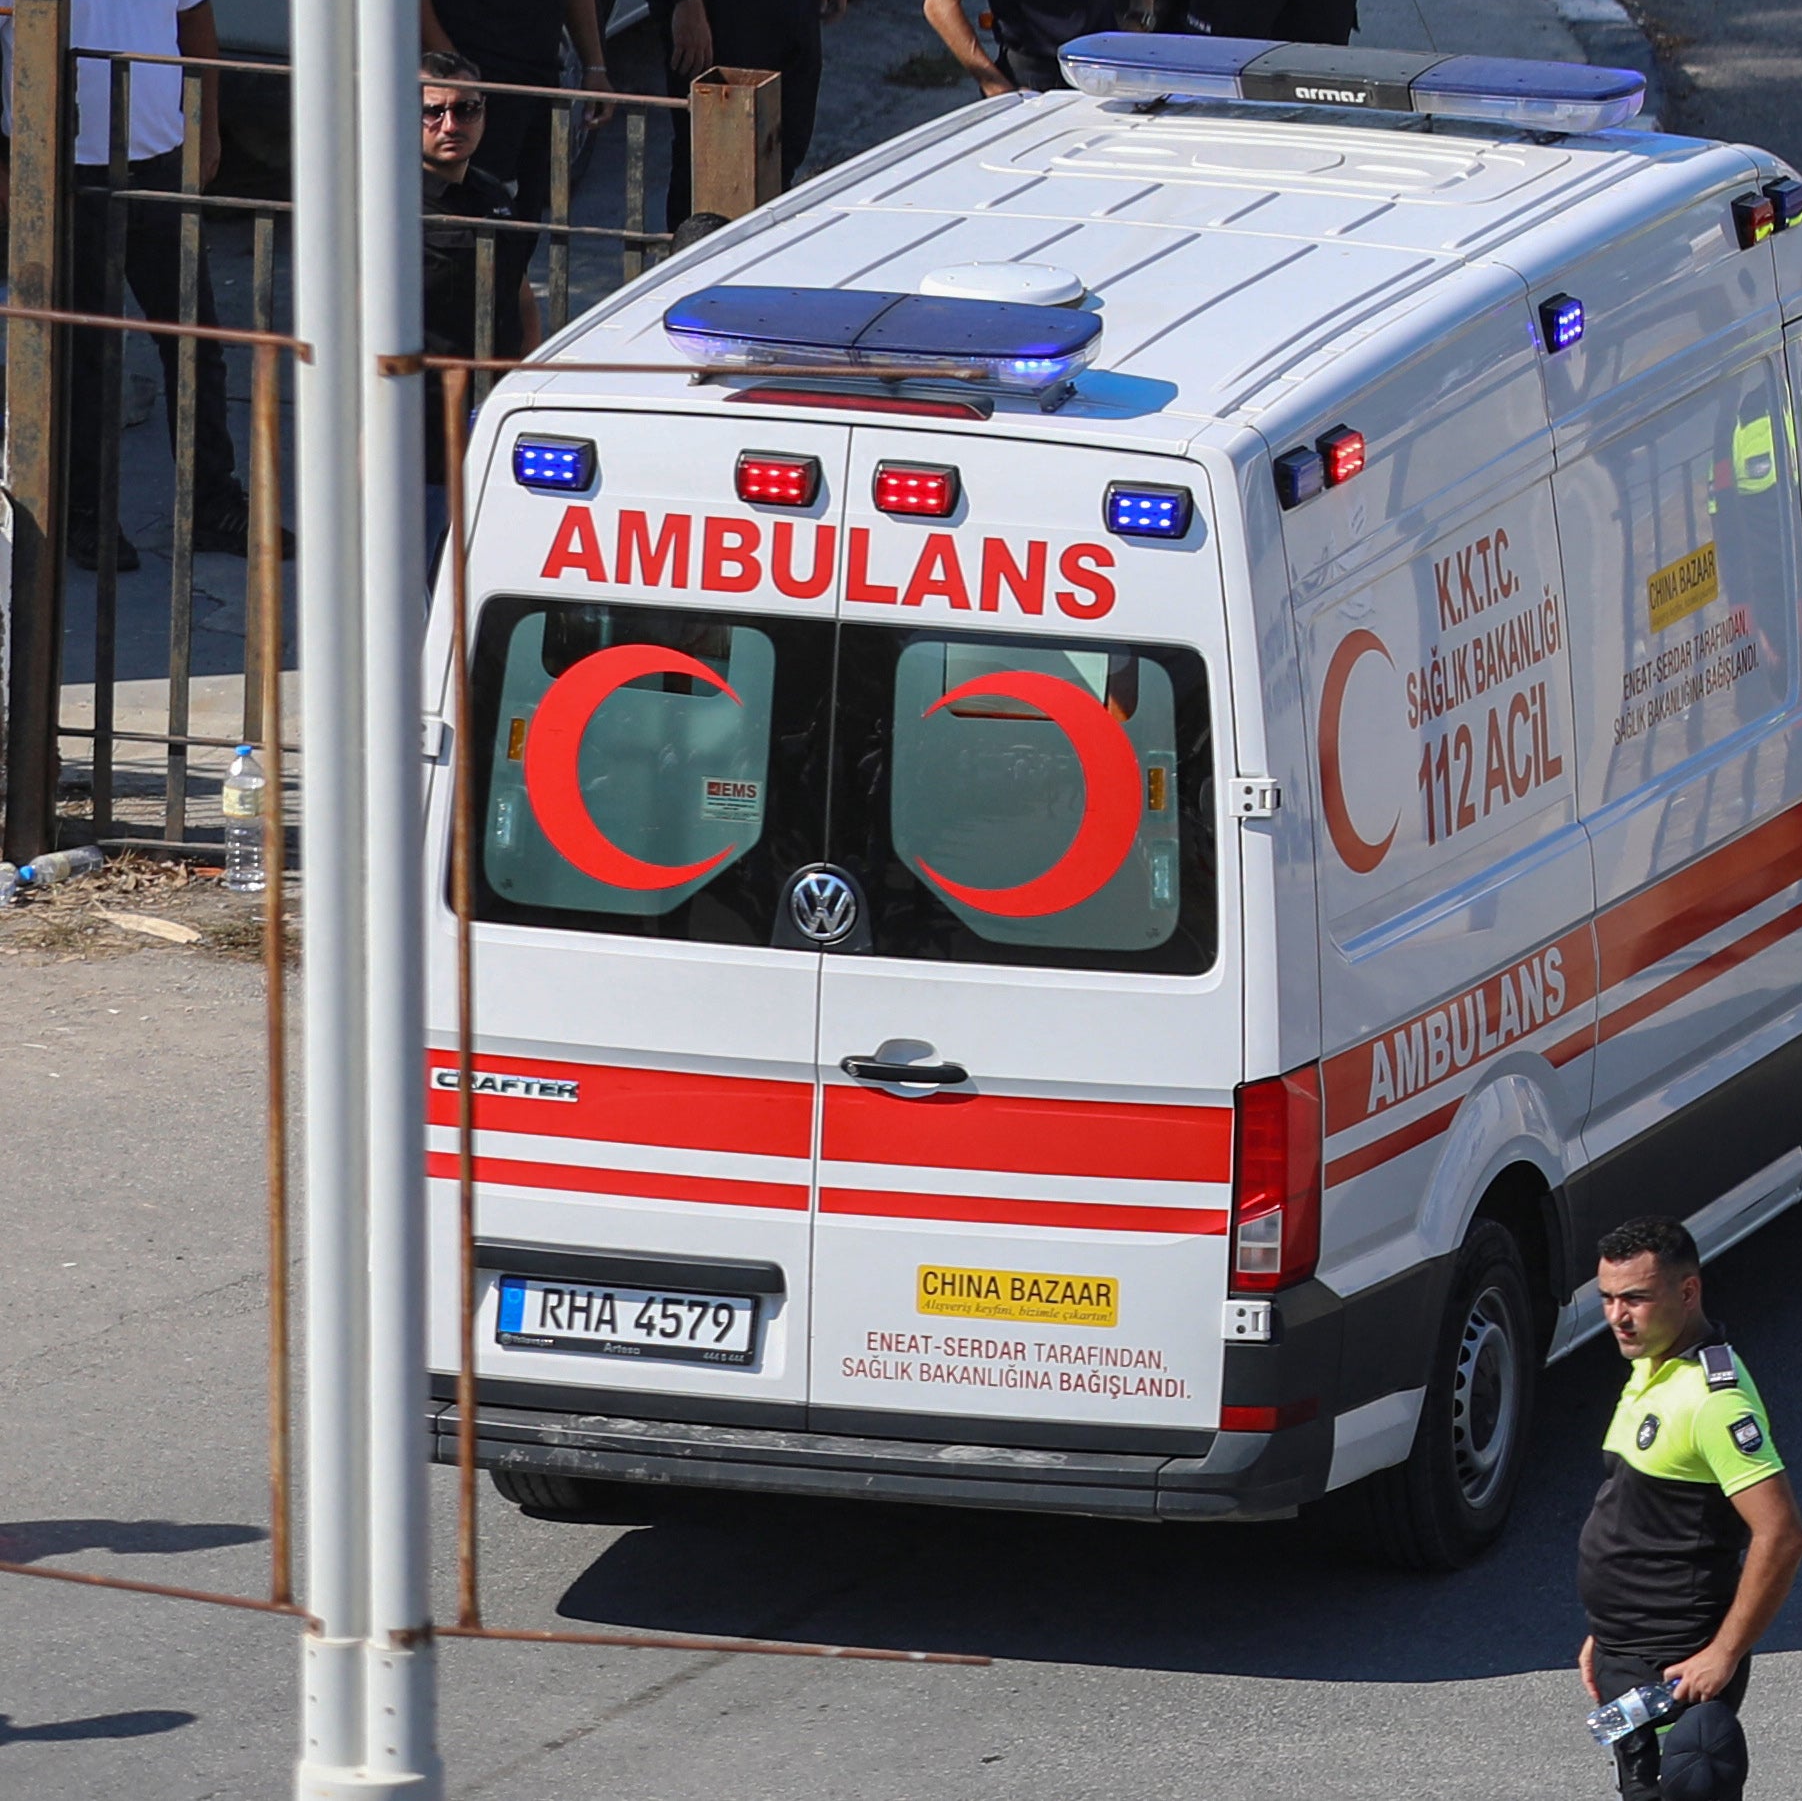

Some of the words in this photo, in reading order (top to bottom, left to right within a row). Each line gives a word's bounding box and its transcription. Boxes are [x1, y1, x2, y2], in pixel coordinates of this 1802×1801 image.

[540, 505, 1117, 620] AMBULANS
[1434, 528, 1520, 631] K.K.T.C.
[1650, 571, 1678, 610] CHINA
[1679, 550, 1715, 594] BAZAAR
[1407, 645, 1472, 730] SAĞLIK
[1472, 584, 1562, 696] BAKANLIĞI
[1623, 640, 1693, 701] ENEAT-SERDAR
[1614, 706, 1647, 745] SAĞLIK
[722, 782, 757, 798] EMS
[1418, 724, 1476, 847] 112
[1483, 682, 1563, 817] ACİL
[1367, 947, 1565, 1113] AMBULANS
[540, 1288, 617, 1334] RHA
[634, 1296, 735, 1344] 4579
[922, 1271, 1001, 1300] CHINA
[1010, 1278, 1112, 1307] BAZAAR
[842, 1355, 913, 1382] SAĞLIK
[919, 1363, 1053, 1391] BAKANLIĞINA
[1060, 1369, 1192, 1400] BAĞIŞLANDI.
[866, 1331, 1027, 1361] ENEAT-SERDAR
[1034, 1343, 1169, 1374] TARAFINDAN,
